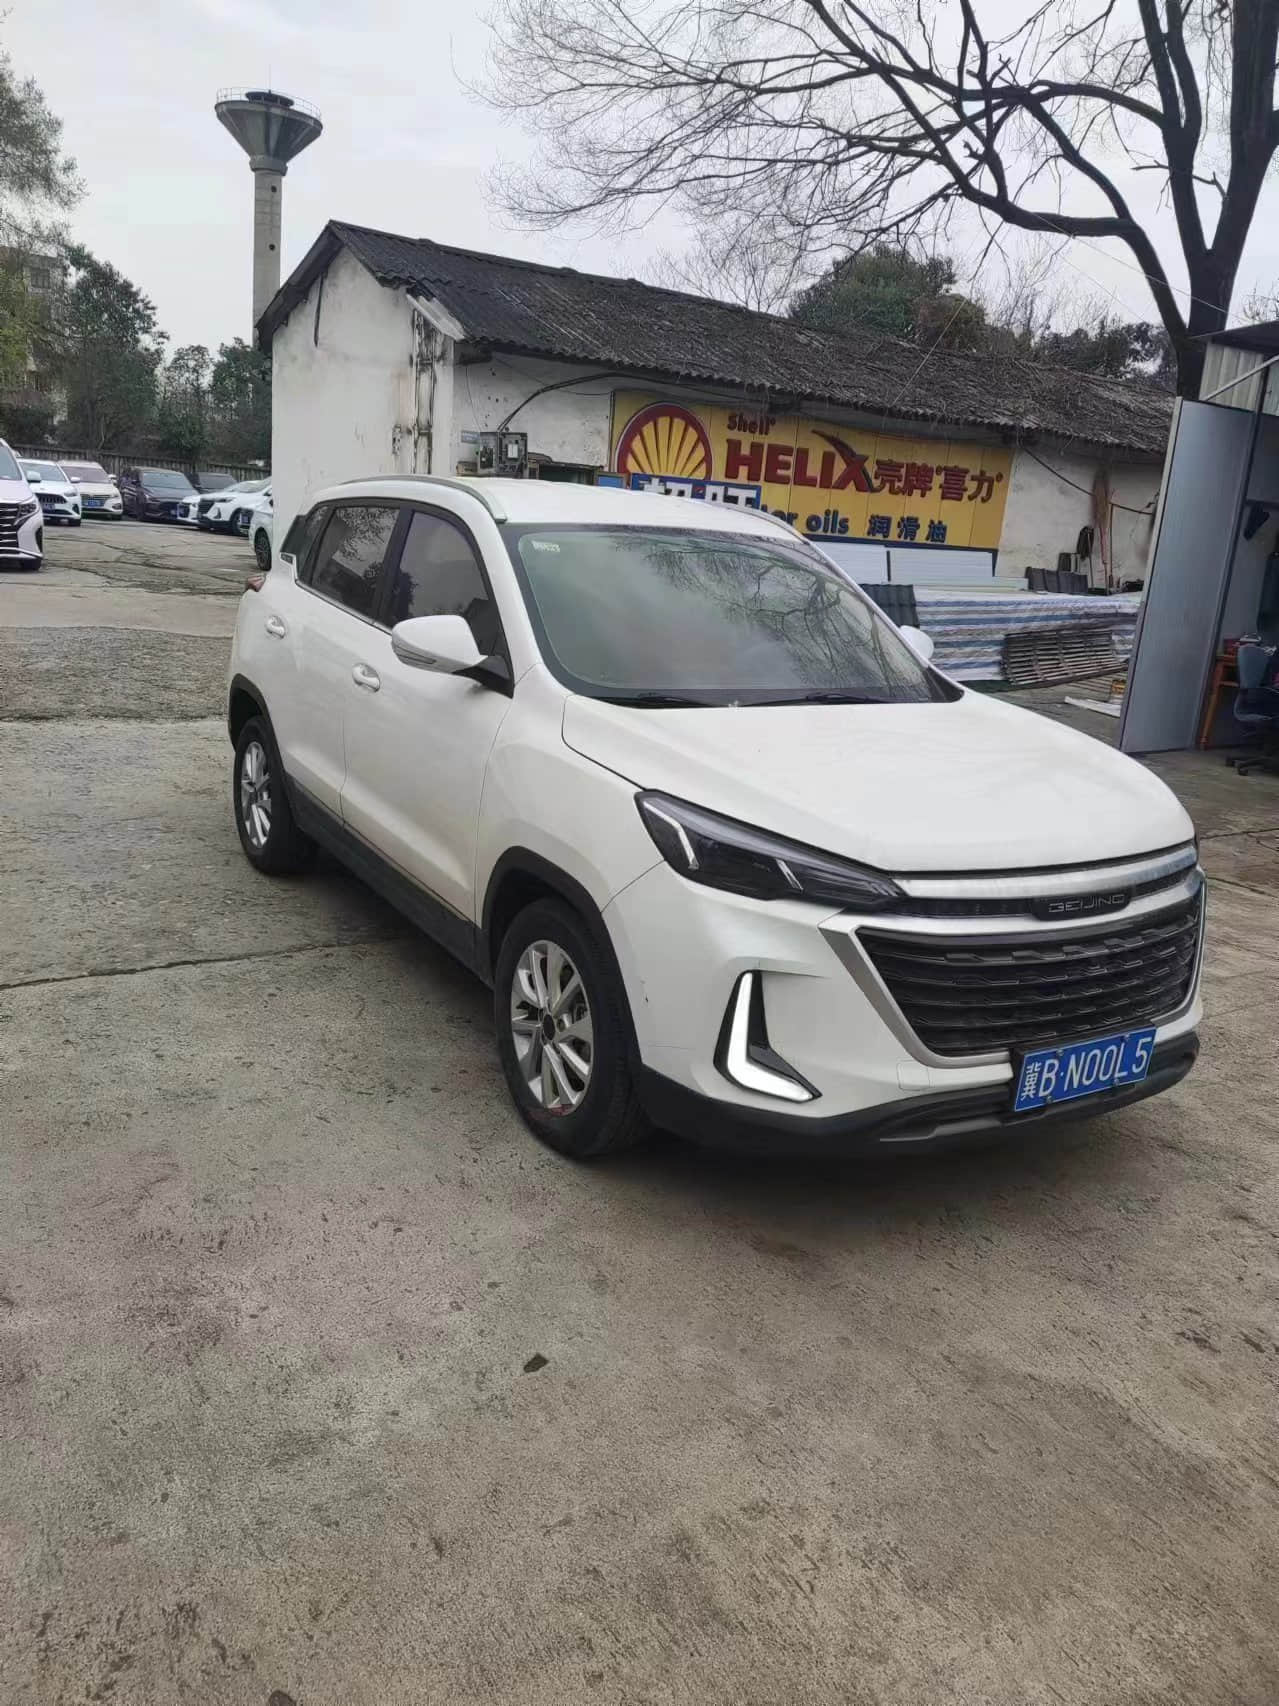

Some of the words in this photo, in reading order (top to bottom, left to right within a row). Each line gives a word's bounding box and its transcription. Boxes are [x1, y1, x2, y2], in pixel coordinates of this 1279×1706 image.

[725, 429, 879, 493] HELIX
[805, 509, 850, 534] oils
[867, 514, 947, 543] 润滑油
